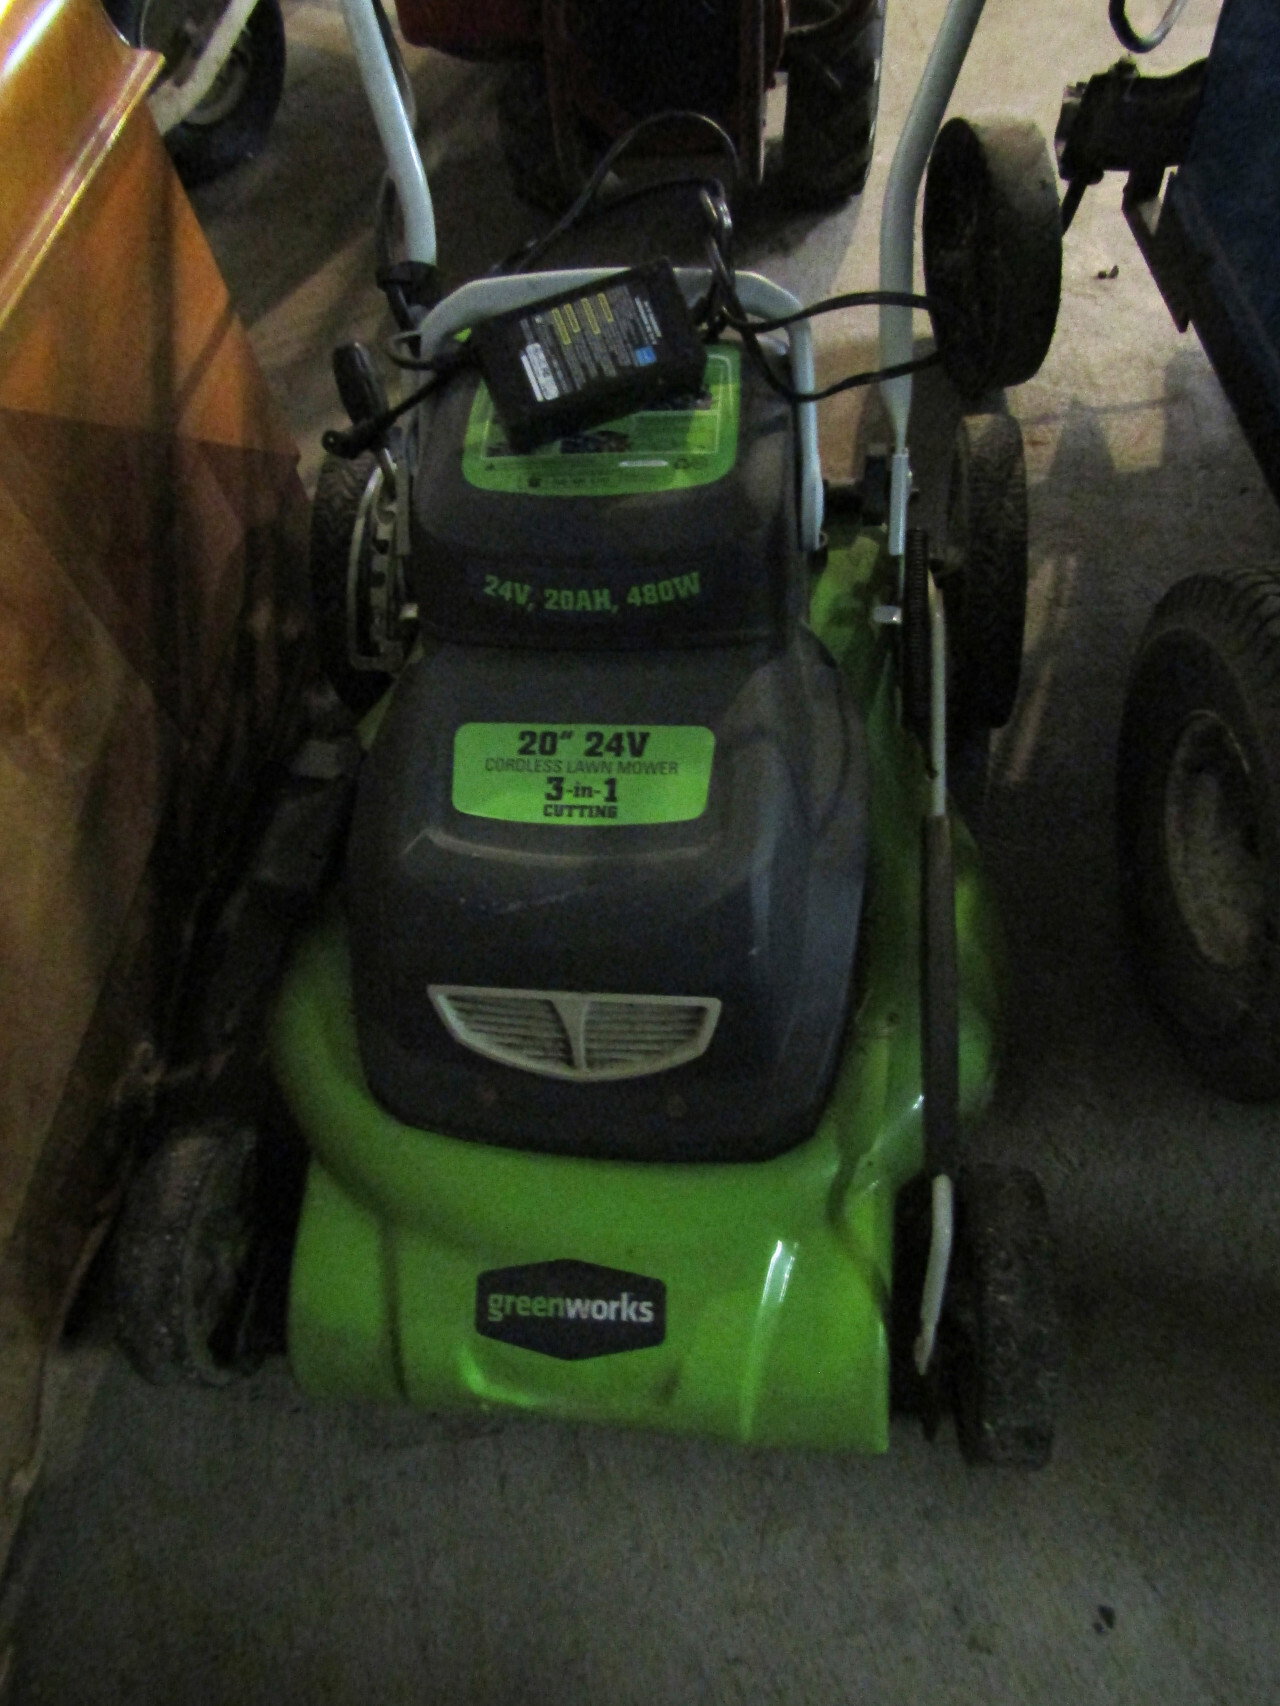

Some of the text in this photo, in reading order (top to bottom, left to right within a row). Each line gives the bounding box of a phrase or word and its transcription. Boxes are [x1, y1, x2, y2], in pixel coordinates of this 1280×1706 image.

[483, 570, 702, 613] 24V, 20AH, 480W
[584, 731, 650, 757] 24V
[485, 757, 679, 775] CORDLESS LAWN MOWER
[545, 776, 618, 802] 3-in-1
[543, 804, 618, 818] CUTTING
[487, 1292, 655, 1323] greenworks
